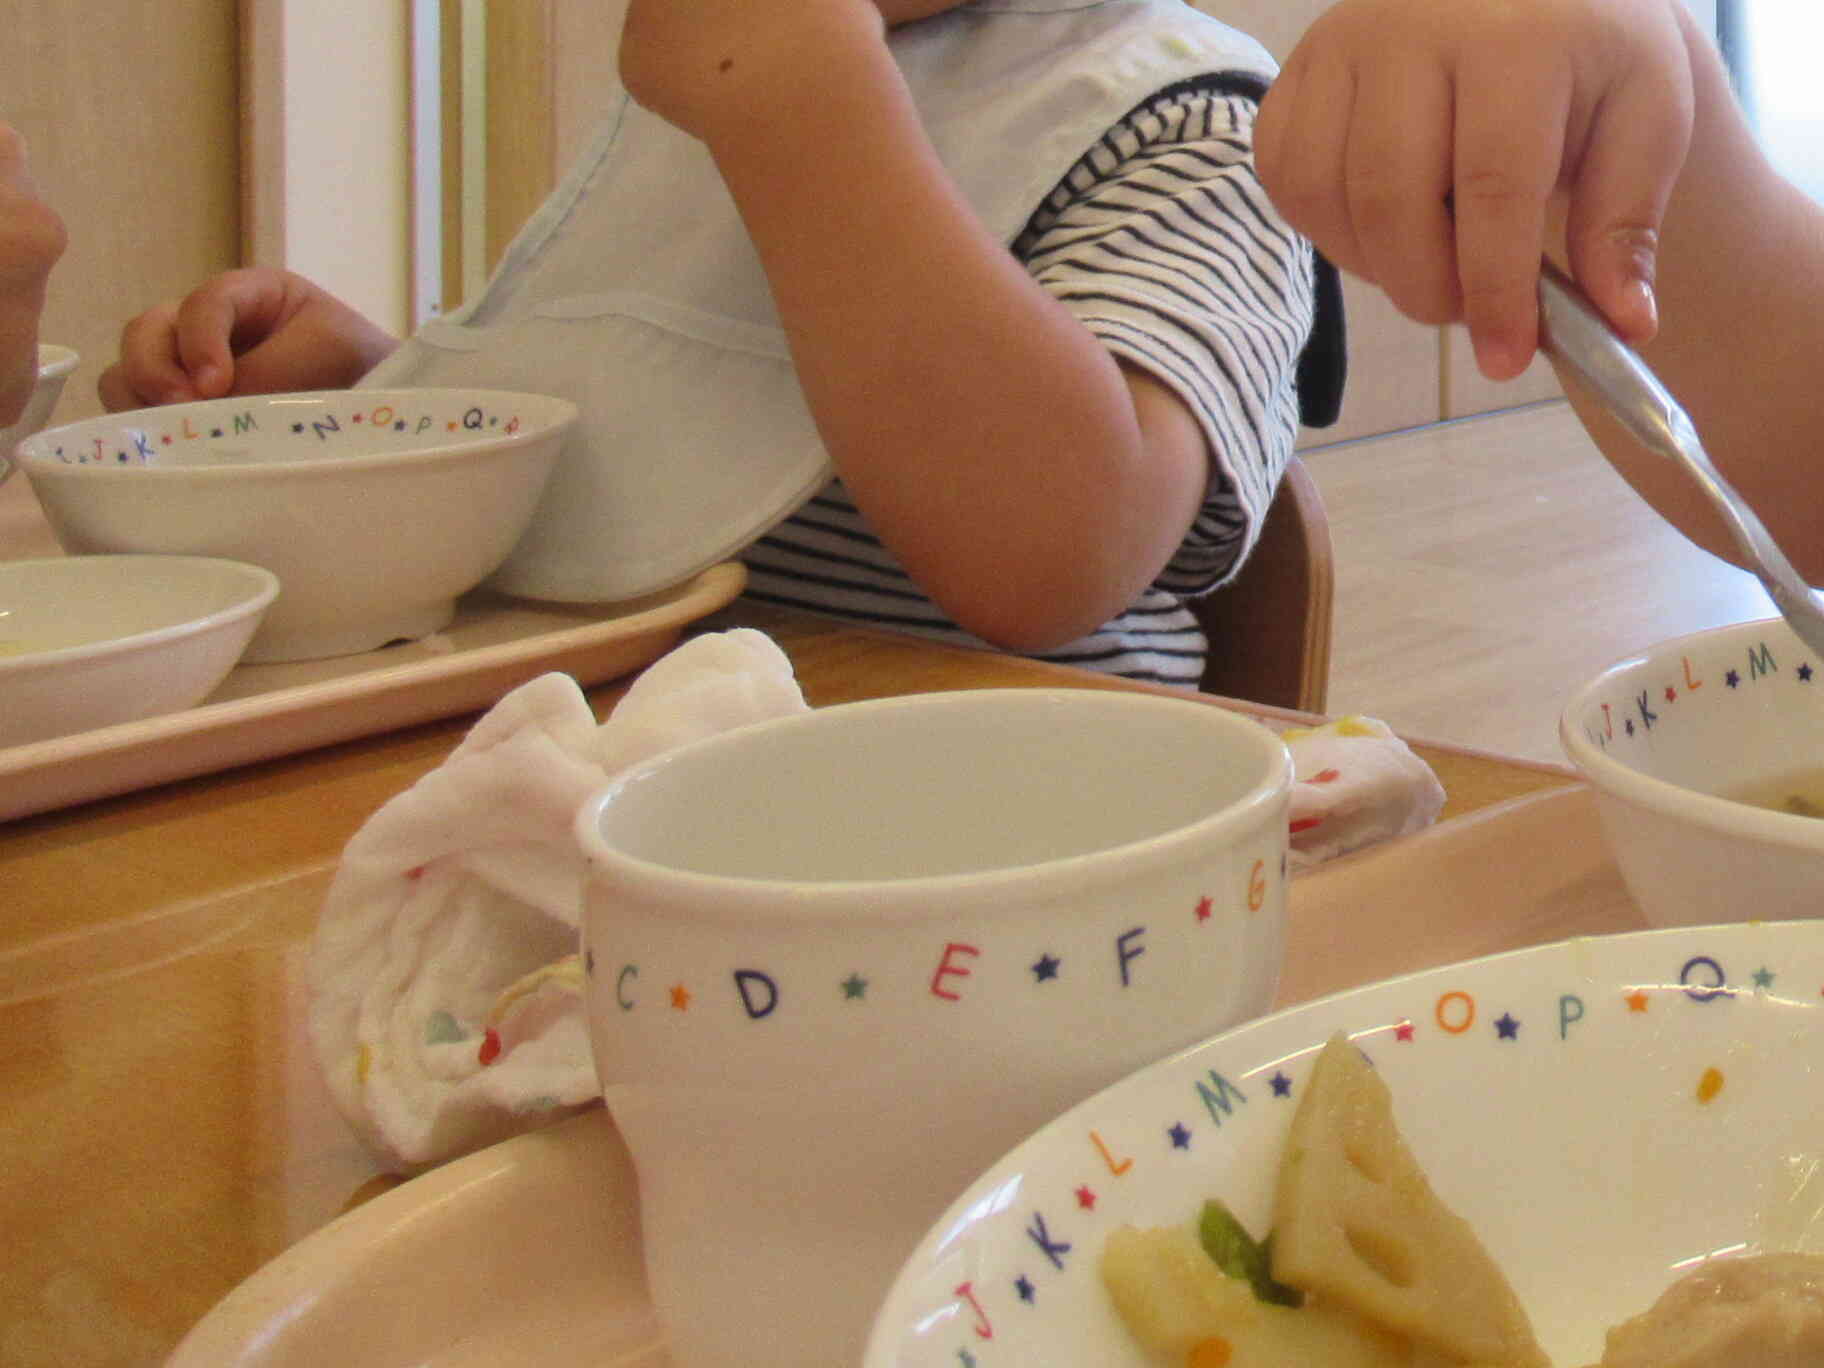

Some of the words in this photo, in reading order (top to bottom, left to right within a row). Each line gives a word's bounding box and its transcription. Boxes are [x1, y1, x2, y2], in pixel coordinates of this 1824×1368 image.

[135, 433, 155, 460] K
[182, 418, 201, 440] L
[231, 411, 257, 436] M
[311, 414, 341, 440] N
[370, 406, 394, 427] O
[415, 415, 433, 436] P
[463, 407, 483, 430] Q
[1636, 689, 1658, 731] K
[1682, 658, 1703, 692] L
[1748, 642, 1778, 681] M
[615, 964, 641, 1012] C
[733, 969, 779, 1020] D
[929, 942, 981, 1001] E
[1116, 927, 1147, 987] F
[954, 1281, 993, 1341] J
[1026, 1212, 1073, 1270] K
[1089, 1132, 1134, 1177] L
[1195, 1069, 1248, 1127] M
[1435, 991, 1476, 1036] O
[1559, 994, 1585, 1041] P
[1679, 956, 1736, 1004] Q
